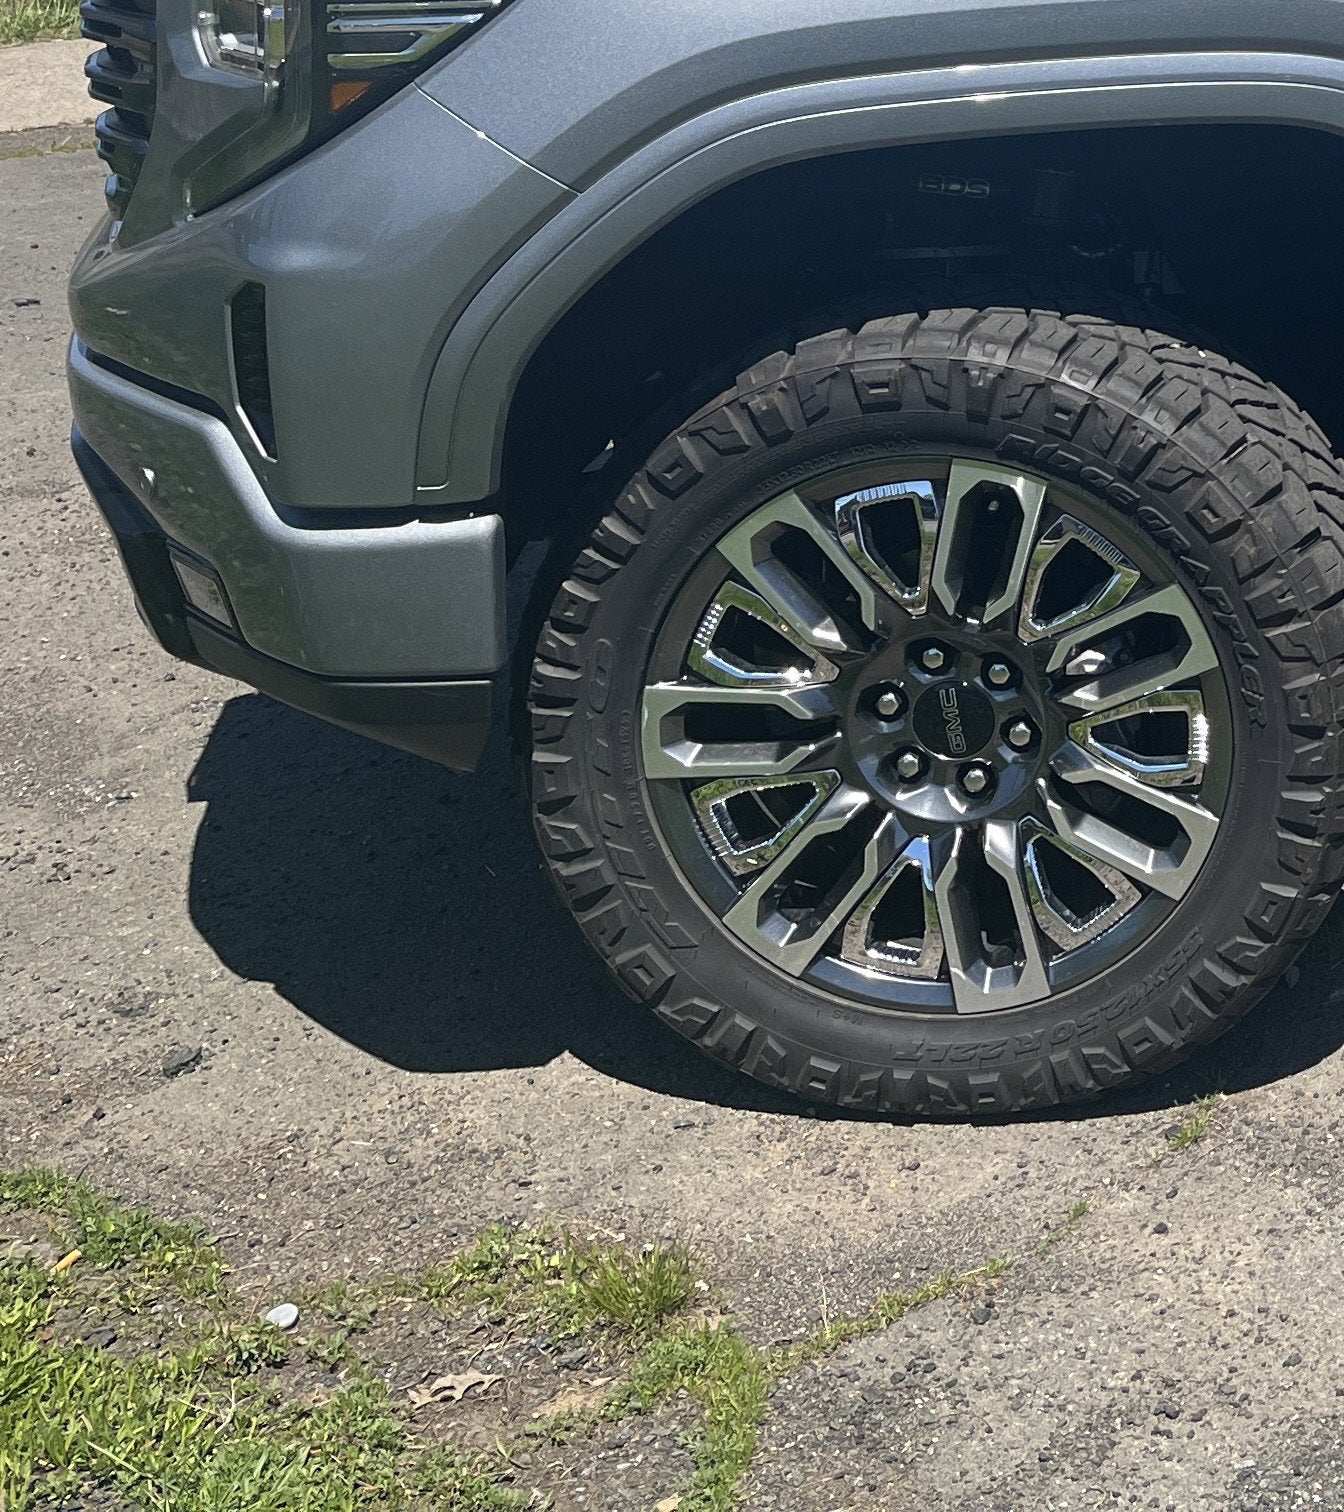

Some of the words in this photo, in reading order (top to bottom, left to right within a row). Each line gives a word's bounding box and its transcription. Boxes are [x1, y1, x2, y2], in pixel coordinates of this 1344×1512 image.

[995, 433, 1142, 510] RIDGE
[1135, 505, 1269, 730] GRAPPLER
[939, 687, 967, 754] GMC
